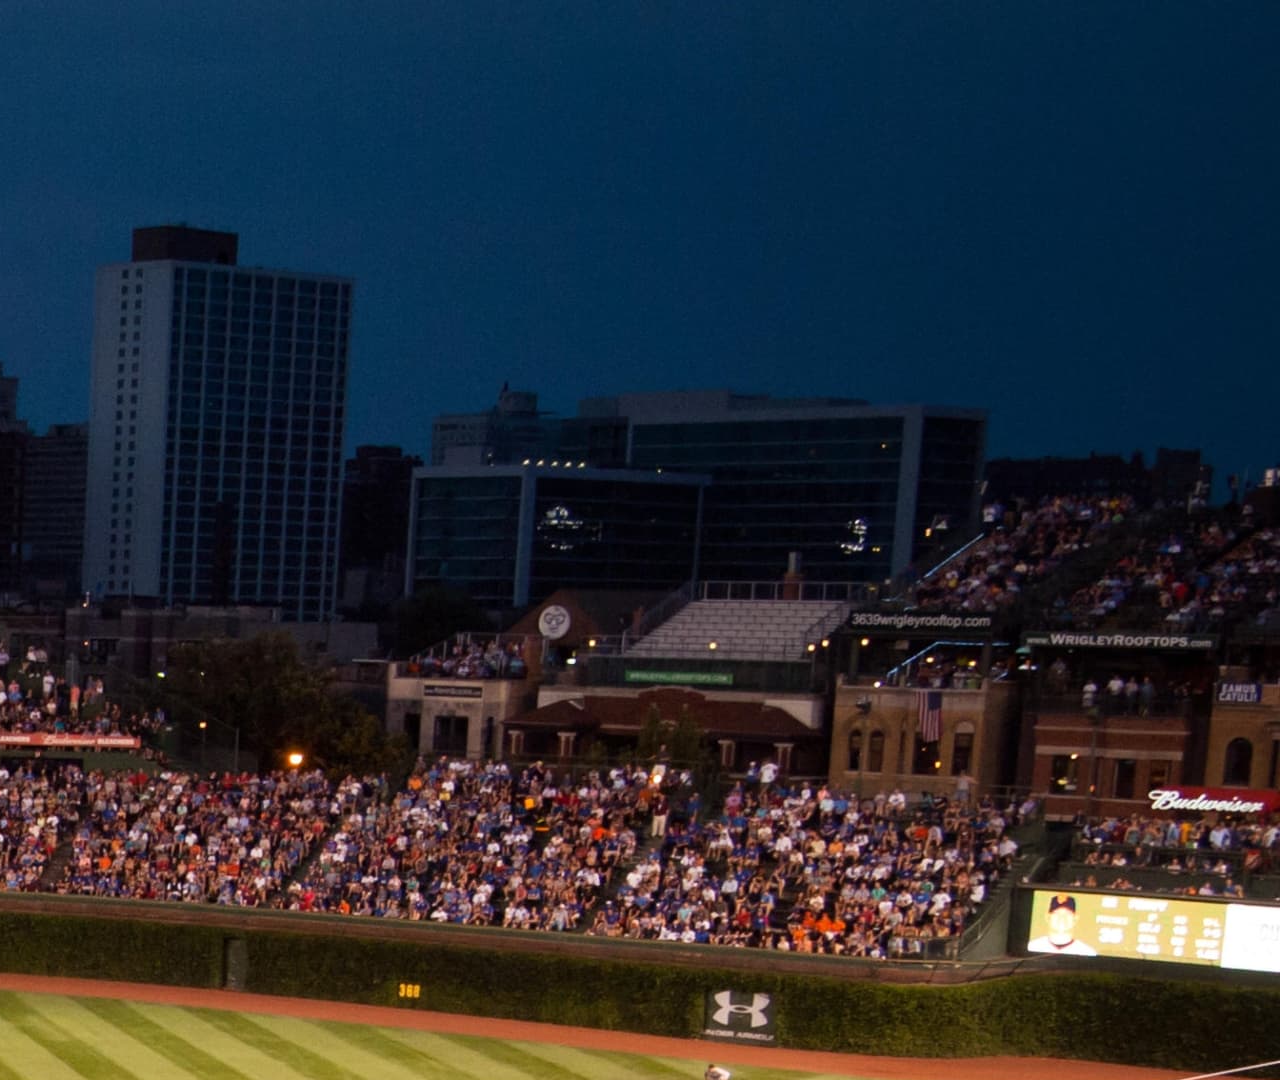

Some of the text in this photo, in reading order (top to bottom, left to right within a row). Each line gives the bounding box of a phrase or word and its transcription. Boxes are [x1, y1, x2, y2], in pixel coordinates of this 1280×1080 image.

[852, 613, 991, 628] 3639wrigleyrooftop.com
[1148, 790, 1264, 812] Budweiser
[736, 1032, 774, 1040] ARMOUR
